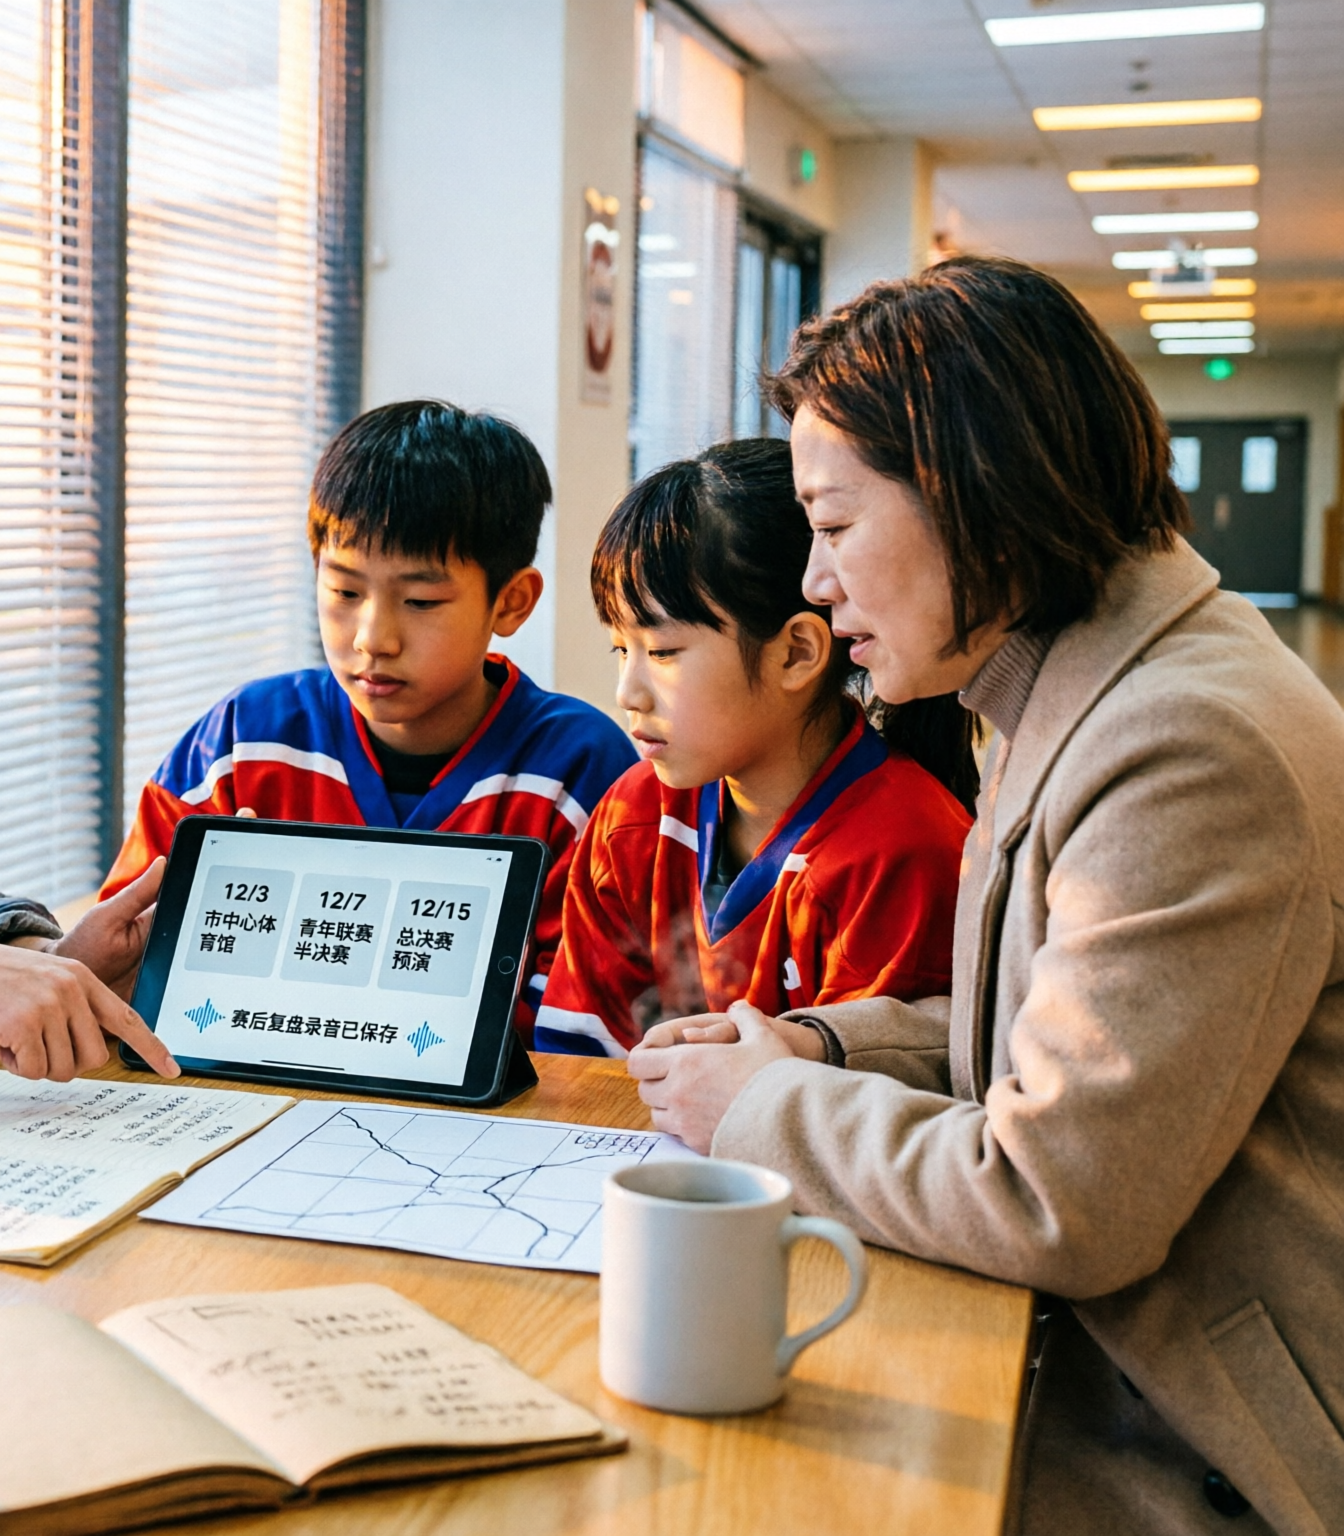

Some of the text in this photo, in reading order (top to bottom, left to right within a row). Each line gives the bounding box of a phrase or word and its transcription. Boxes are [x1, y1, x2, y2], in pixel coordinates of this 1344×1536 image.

[224, 882, 270, 903] 12/3
[320, 890, 367, 911] 12/7
[204, 909, 277, 934] 市中心体
[411, 898, 472, 921] 12/15
[299, 917, 374, 944] 青年联赛
[396, 926, 455, 952] 总决赛
[199, 932, 236, 954] 育馆
[293, 940, 351, 965] 半决赛
[391, 950, 432, 973] 预演
[230, 1009, 399, 1044] 赛后复盘录音已保存
